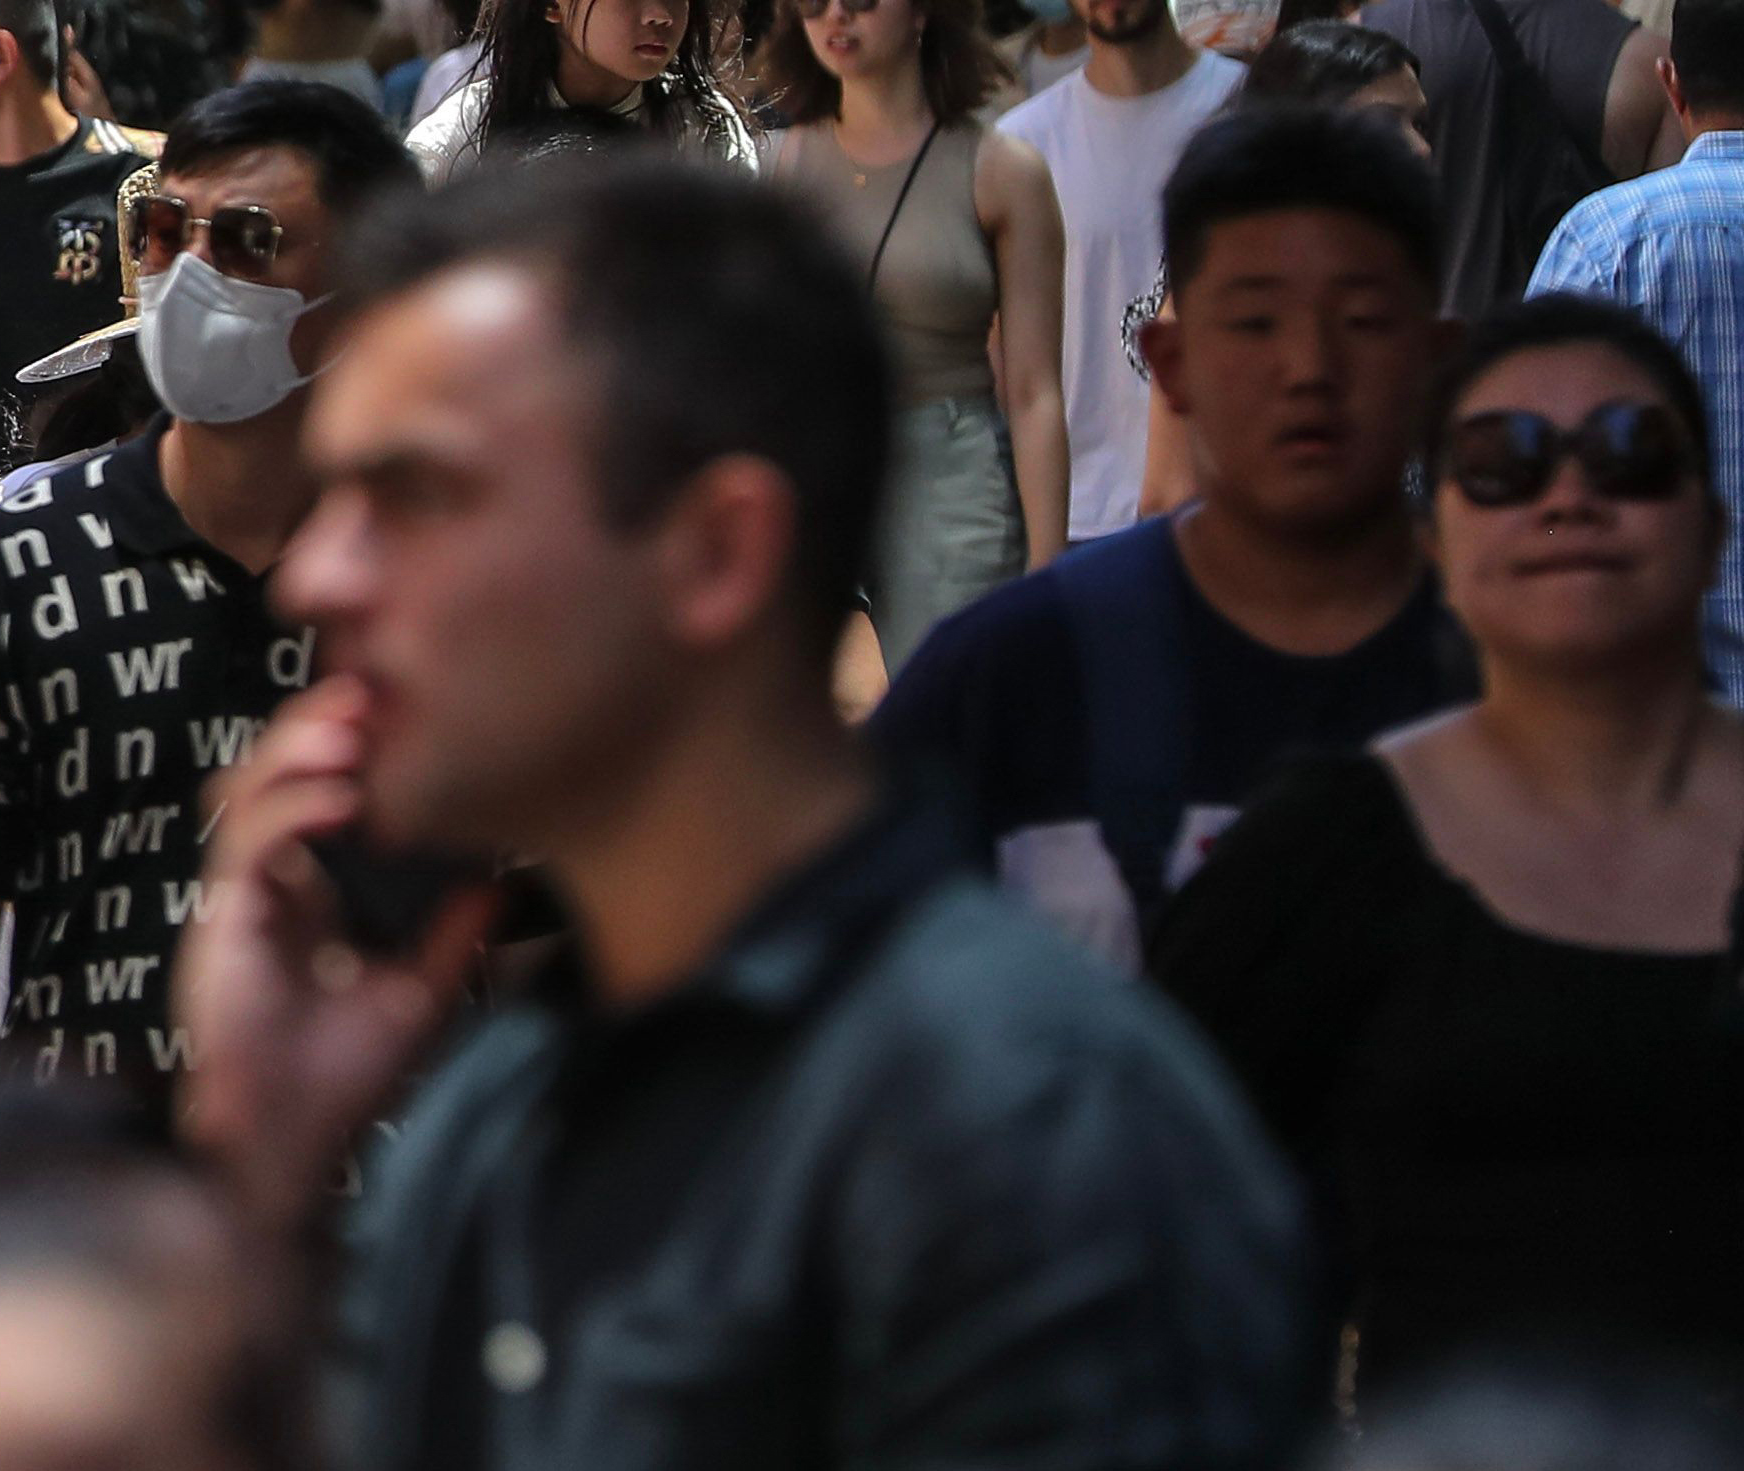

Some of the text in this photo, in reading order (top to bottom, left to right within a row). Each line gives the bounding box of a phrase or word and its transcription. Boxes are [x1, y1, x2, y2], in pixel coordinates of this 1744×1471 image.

[32, 574, 79, 640] d
[101, 566, 149, 618] n
[107, 636, 194, 698] wr
[116, 727, 156, 779] n
